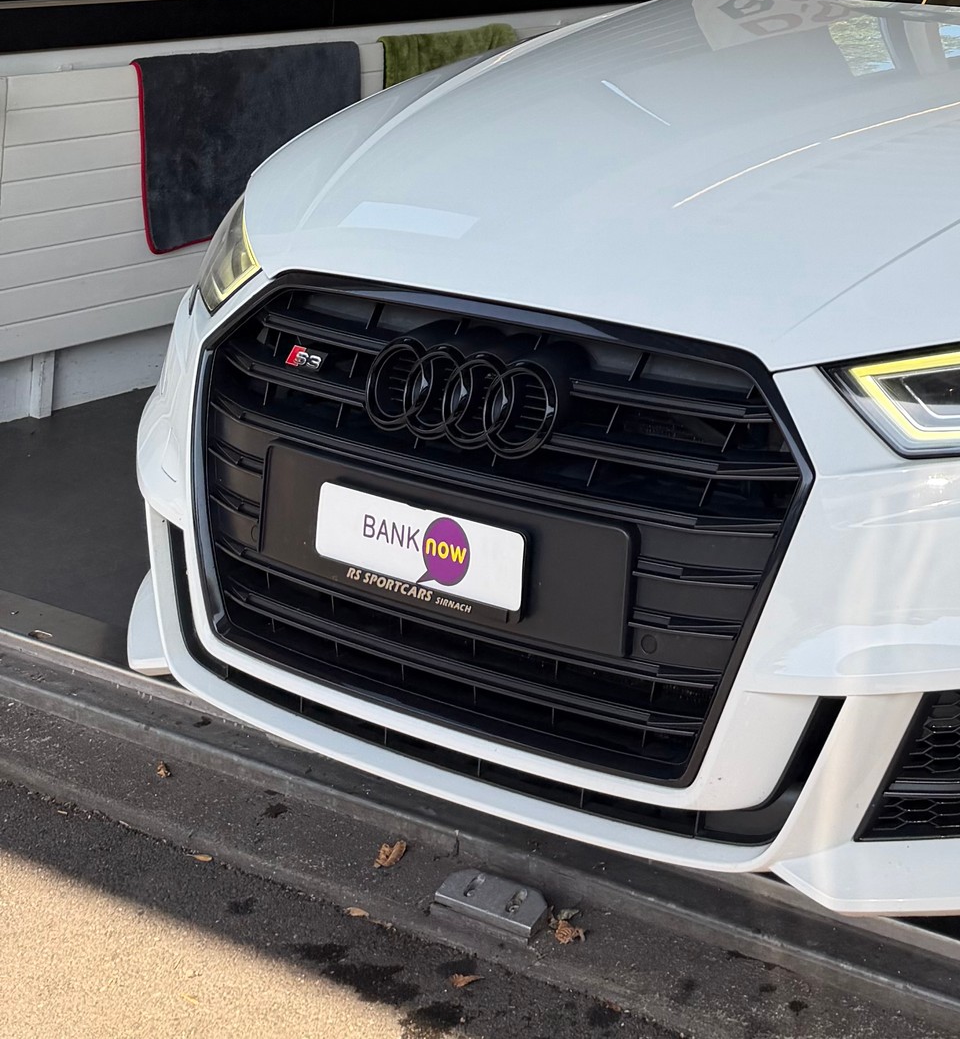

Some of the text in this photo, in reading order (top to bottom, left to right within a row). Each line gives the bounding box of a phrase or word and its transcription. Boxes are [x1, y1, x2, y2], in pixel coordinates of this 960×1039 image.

[292, 351, 322, 369] S3
[363, 514, 467, 564] BANK now
[346, 567, 472, 614] RS SPORTCARS SIRNACH
